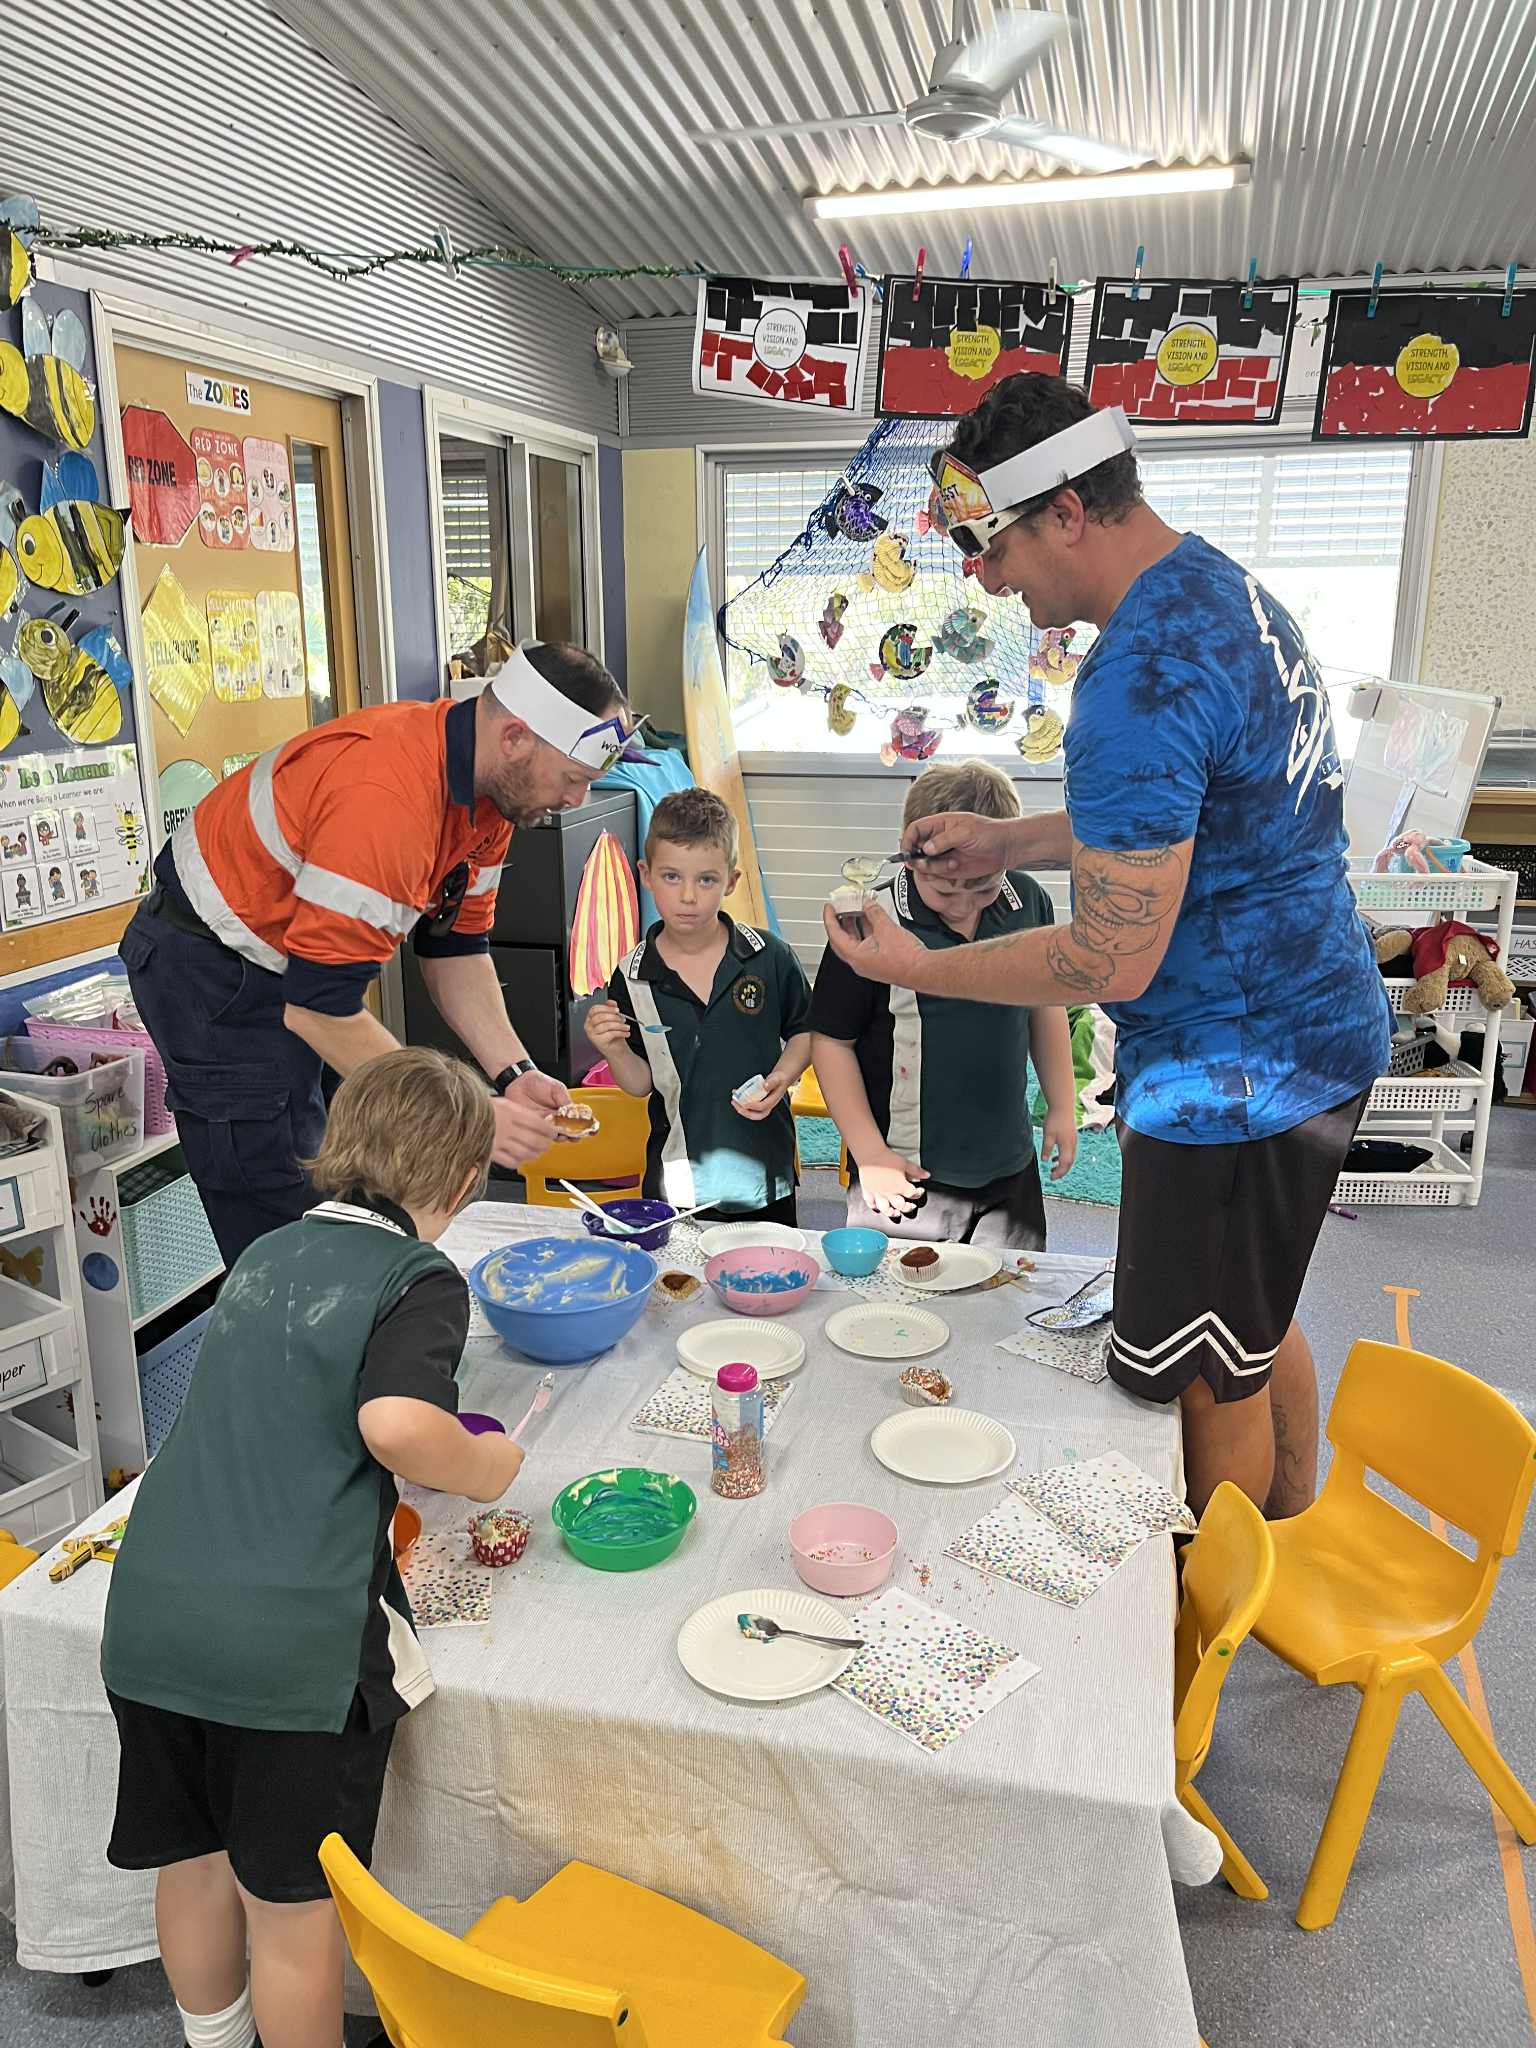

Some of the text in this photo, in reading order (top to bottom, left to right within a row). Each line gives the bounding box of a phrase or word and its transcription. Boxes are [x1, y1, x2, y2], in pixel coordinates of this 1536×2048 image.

[763, 335, 798, 346] VISION AND
[953, 346, 993, 357] VISION AND
[1167, 351, 1208, 360] VISION AND
[1406, 361, 1450, 371] VISION AND
[188, 378, 250, 410] The ZONES
[194, 436, 211, 452] RED
[215, 440, 239, 457] ZONE
[128, 455, 177, 488] RED ZONE
[17, 767, 40, 789] Be
[54, 763, 115, 784] Learner
[163, 805, 192, 834] GRE
[84, 1086, 127, 1121] Spare
[91, 1119, 138, 1152] Clothes
[0, 1363, 26, 1392] per
